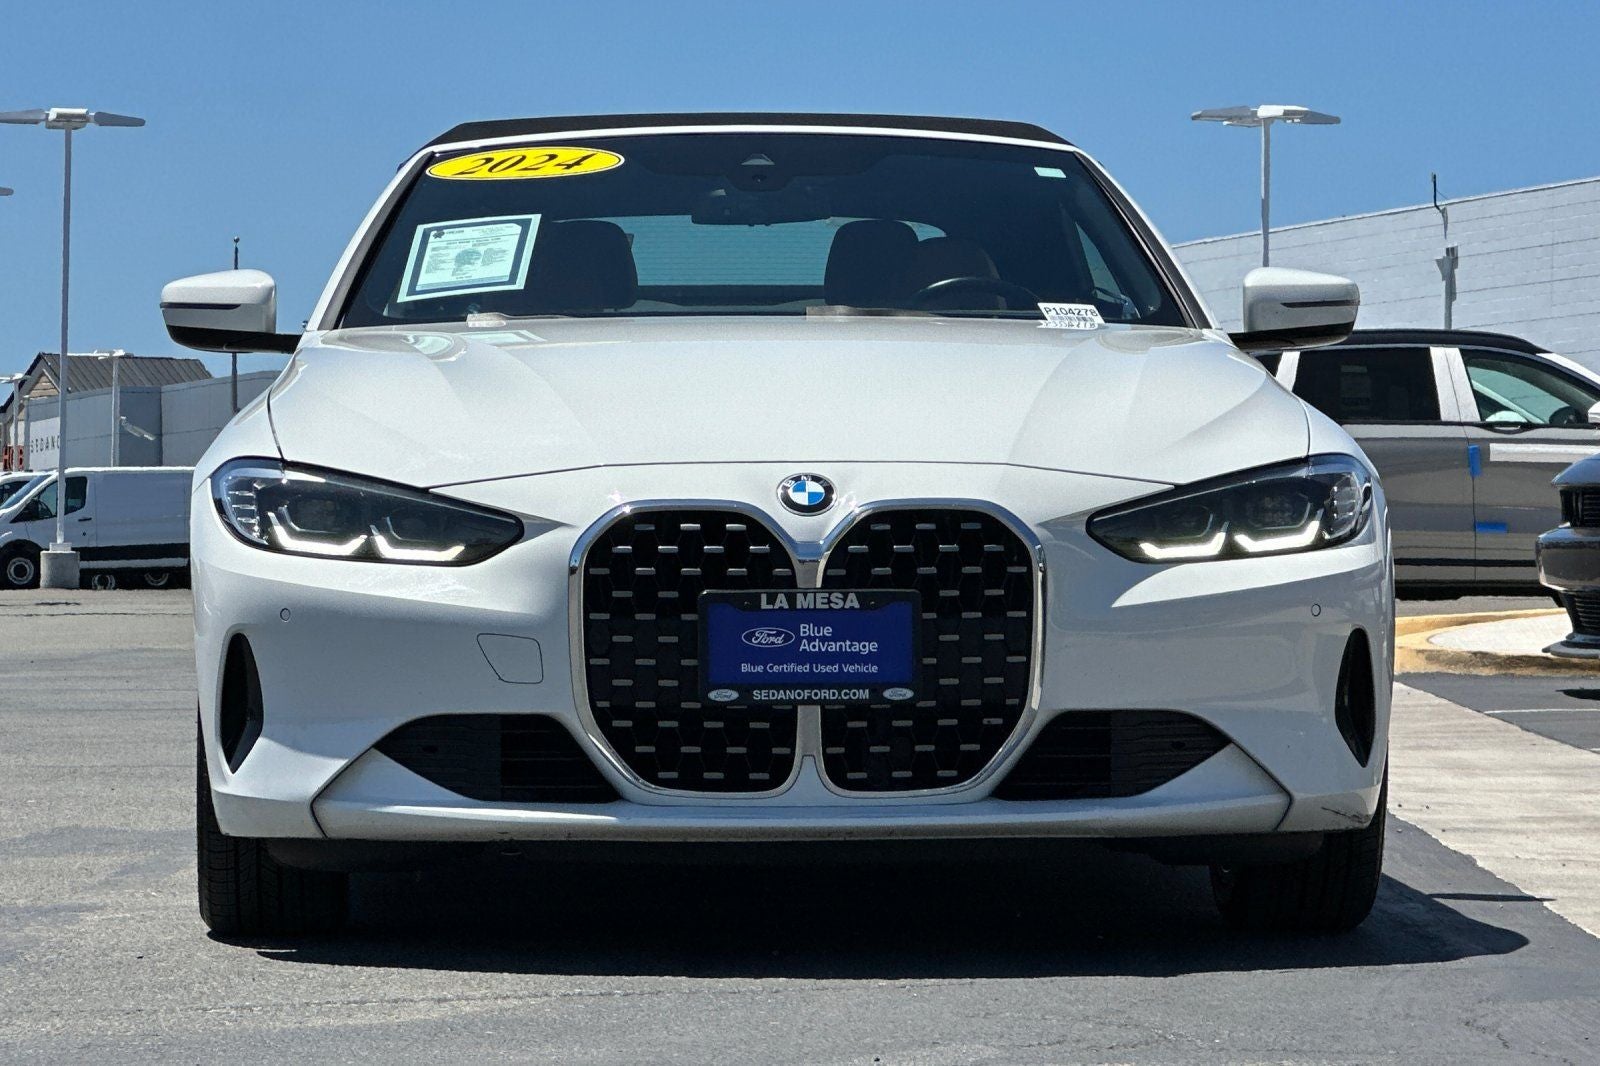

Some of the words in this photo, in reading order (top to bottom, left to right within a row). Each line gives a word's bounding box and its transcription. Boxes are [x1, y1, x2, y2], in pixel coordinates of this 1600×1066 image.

[454, 153, 597, 175] 2024
[1043, 306, 1098, 317] P104278
[782, 475, 829, 488] BMW
[760, 593, 789, 609] LA
[796, 593, 860, 609] MESA
[799, 623, 833, 637] Blue
[751, 629, 785, 646] Ford
[799, 639, 878, 655] Advantage
[741, 663, 764, 673] Blue
[766, 663, 810, 673] Certified
[813, 663, 839, 673] Used
[842, 663, 879, 673] Vehicle
[752, 689, 870, 701] SEDANOFORD.COM
